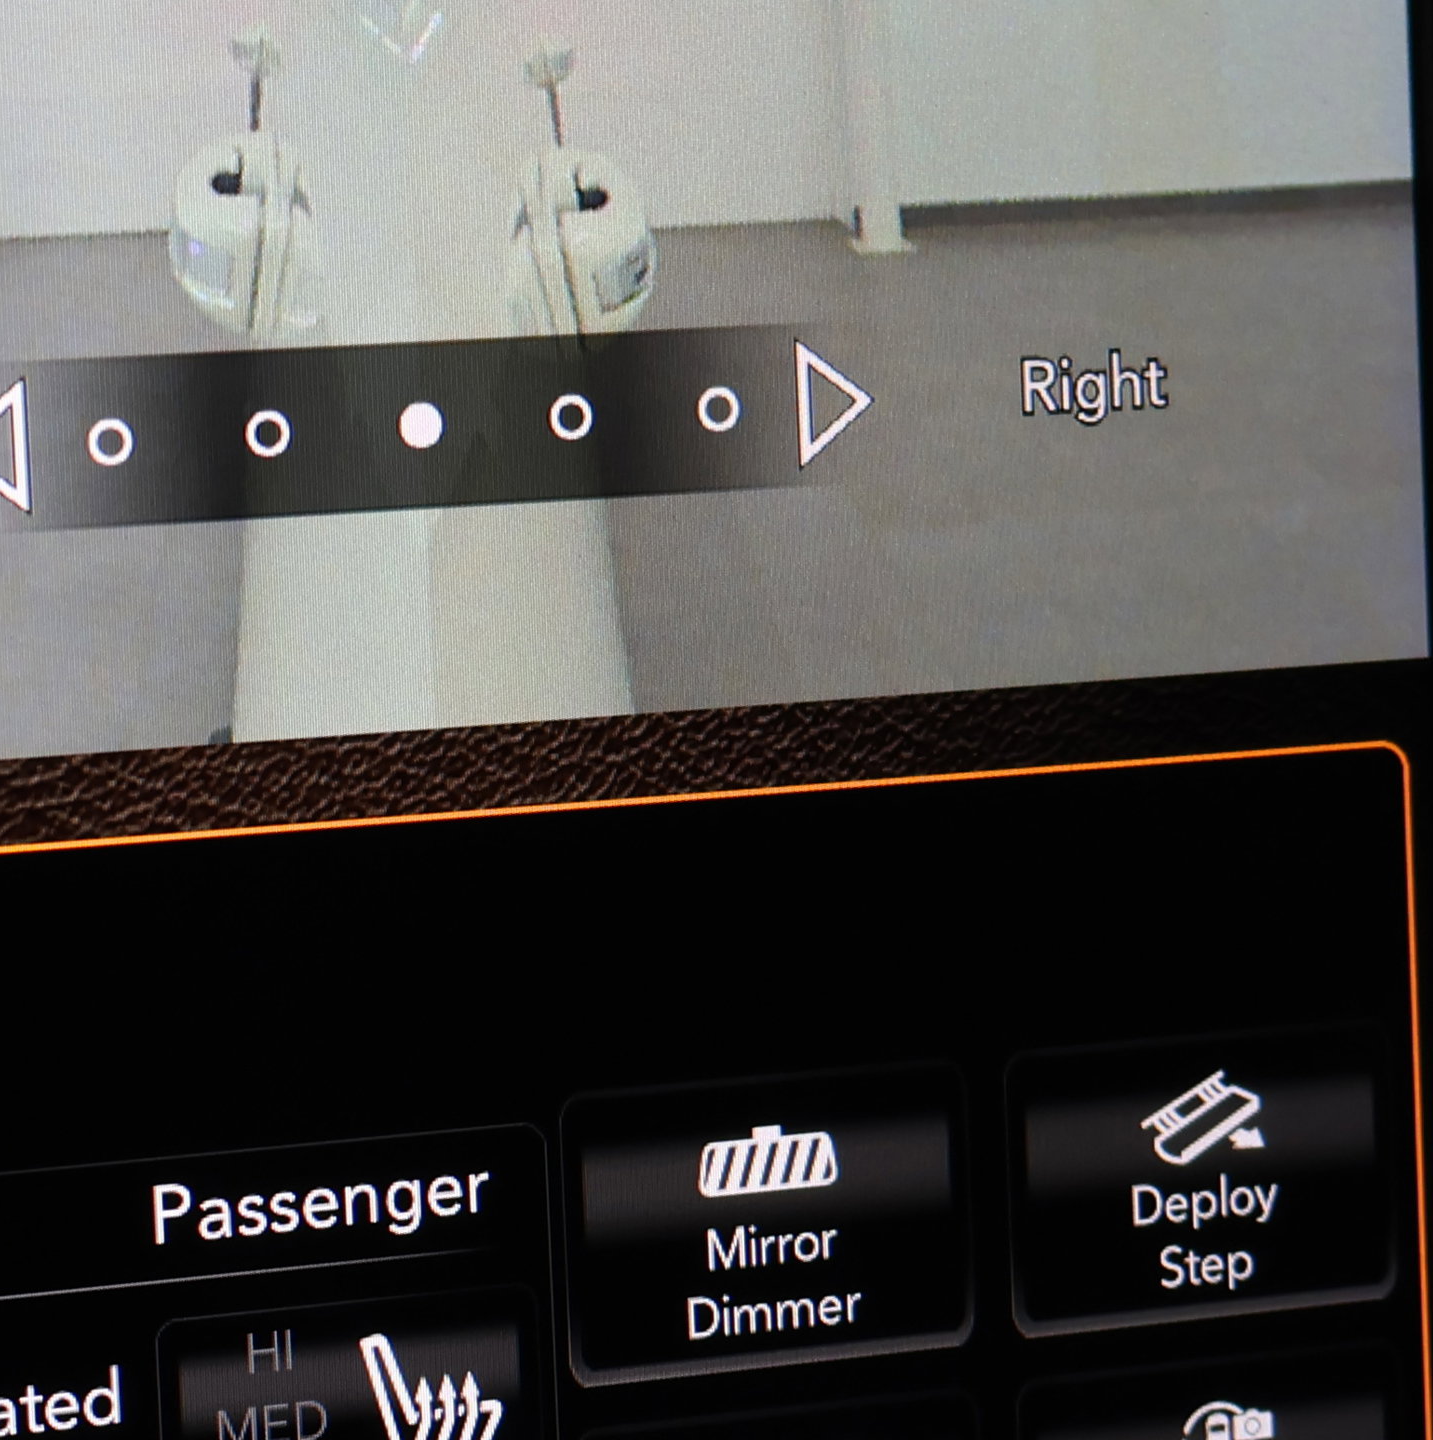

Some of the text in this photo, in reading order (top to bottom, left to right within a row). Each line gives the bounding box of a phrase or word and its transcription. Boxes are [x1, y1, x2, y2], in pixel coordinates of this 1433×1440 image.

[1019, 351, 1171, 428] Right
[150, 1168, 492, 1248] Passenger
[1131, 1174, 1280, 1231] Deploy
[706, 1224, 838, 1275] Mirror
[1158, 1245, 1256, 1298] Step
[686, 1289, 862, 1343] Dimmer
[246, 1330, 294, 1374] HI
